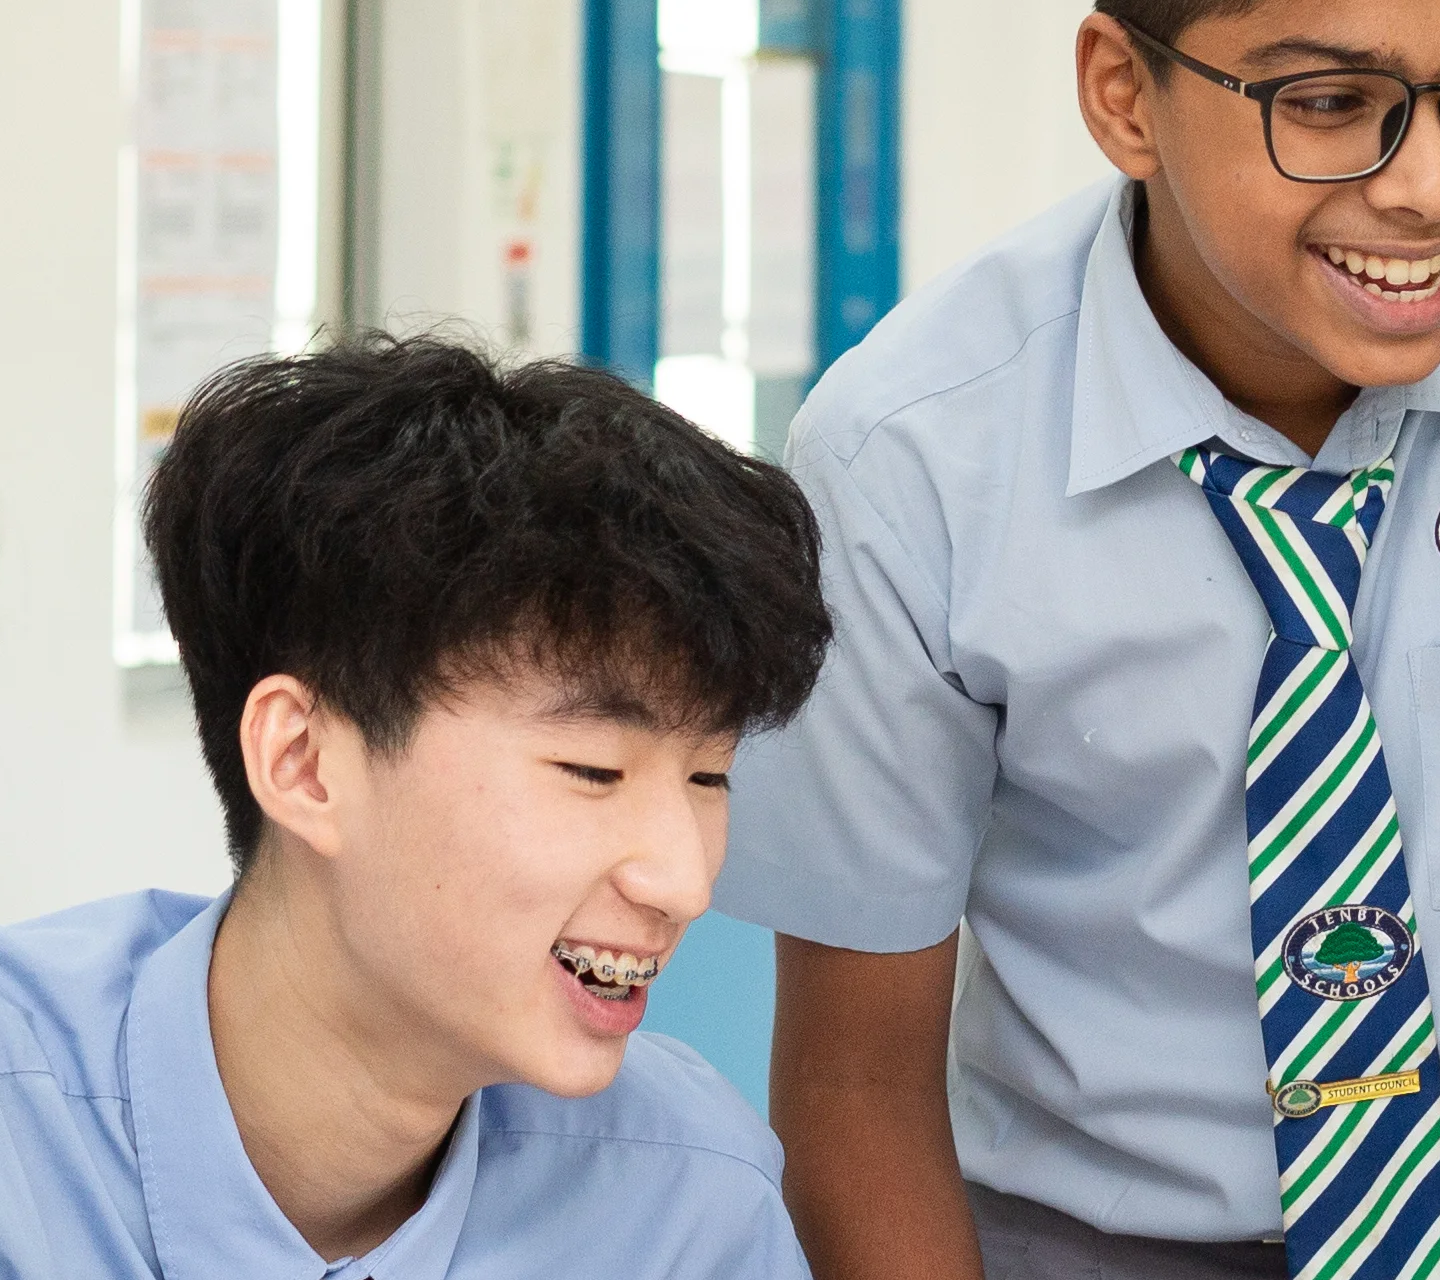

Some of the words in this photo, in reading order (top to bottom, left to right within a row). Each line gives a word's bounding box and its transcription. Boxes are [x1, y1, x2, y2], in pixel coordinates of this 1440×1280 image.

[1308, 908, 1386, 932] TENBY
[1300, 964, 1400, 997] SCHOOLS
[1327, 1085, 1372, 1099] STUDENT
[1374, 1078, 1418, 1091] COUNCIL
